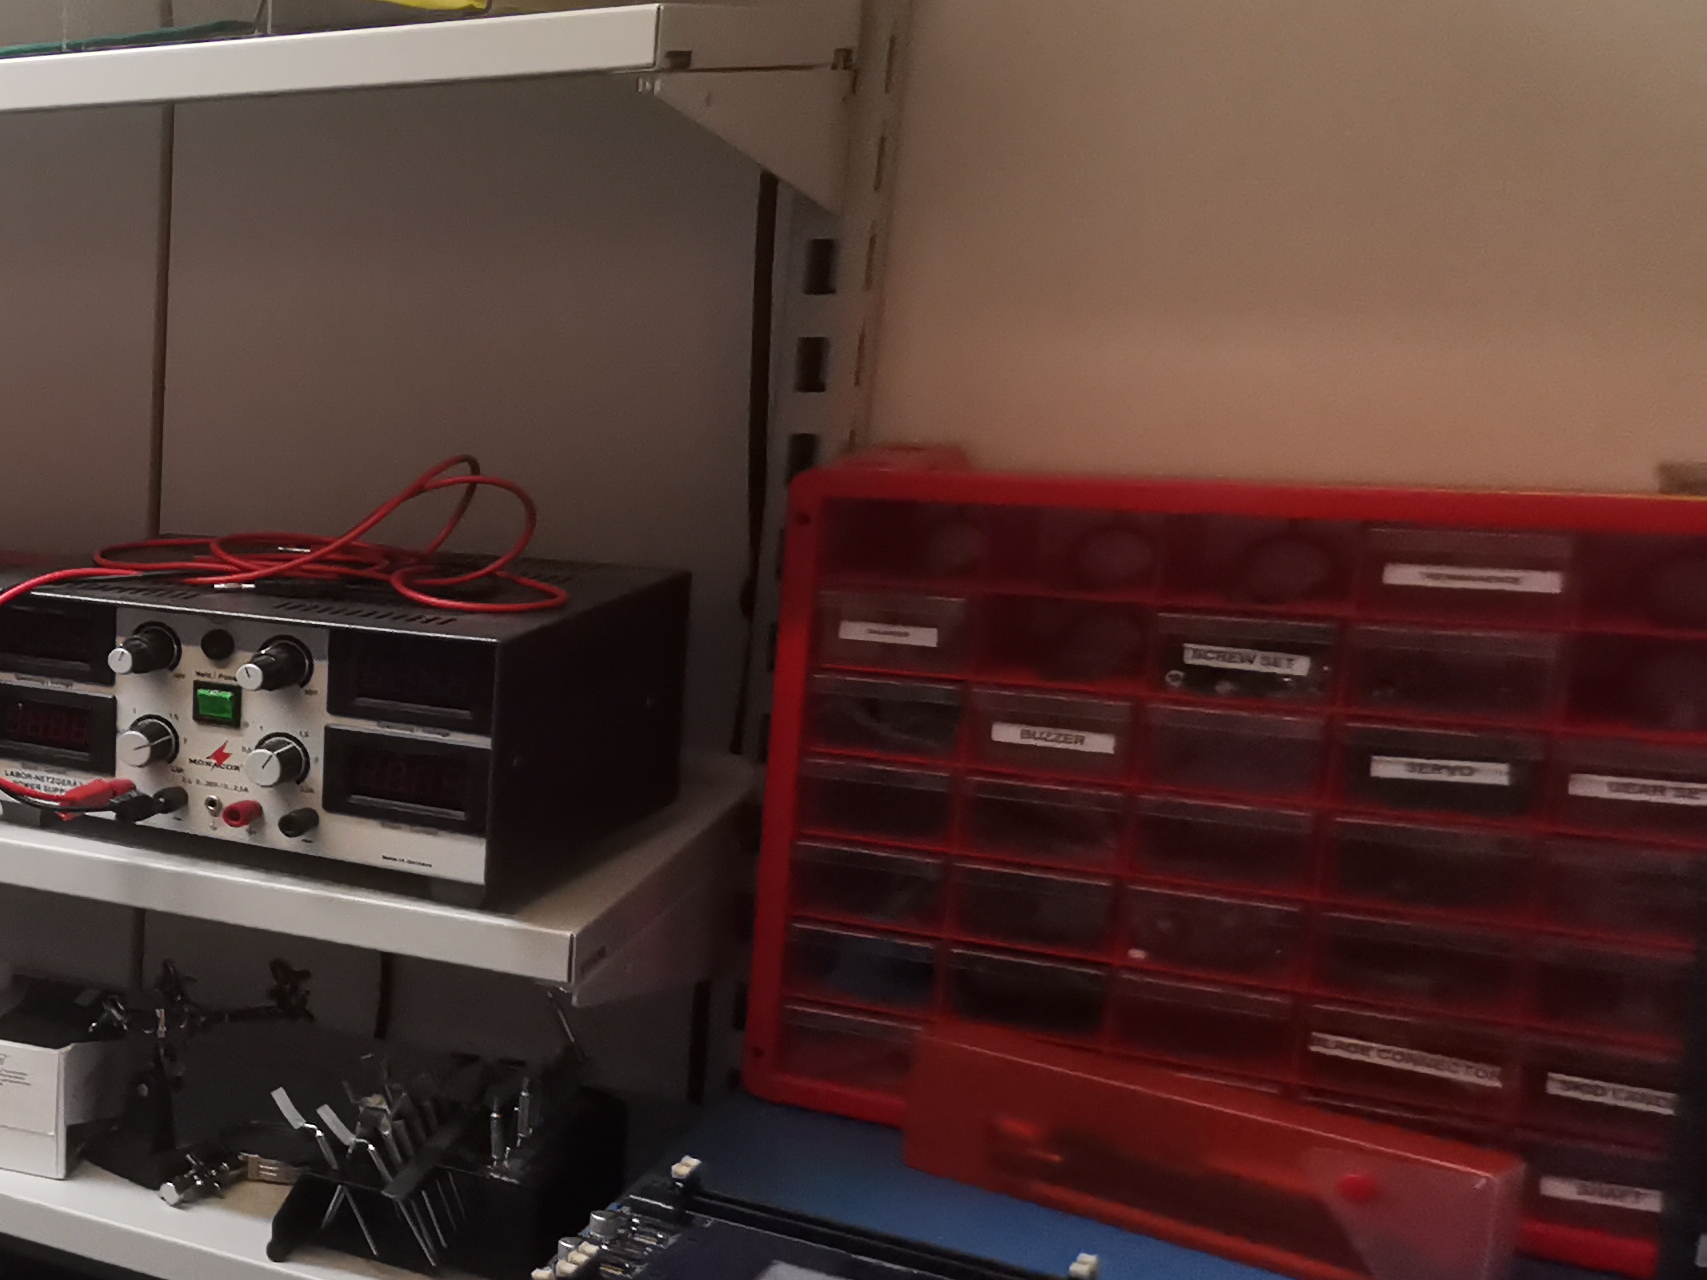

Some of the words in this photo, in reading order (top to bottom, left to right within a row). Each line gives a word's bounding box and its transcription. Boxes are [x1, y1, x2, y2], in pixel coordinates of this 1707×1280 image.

[1191, 648, 1256, 665] SCREW
[1259, 654, 1296, 670] SET
[1020, 728, 1086, 746] BUZZER
[188, 758, 241, 772] MONACOR
